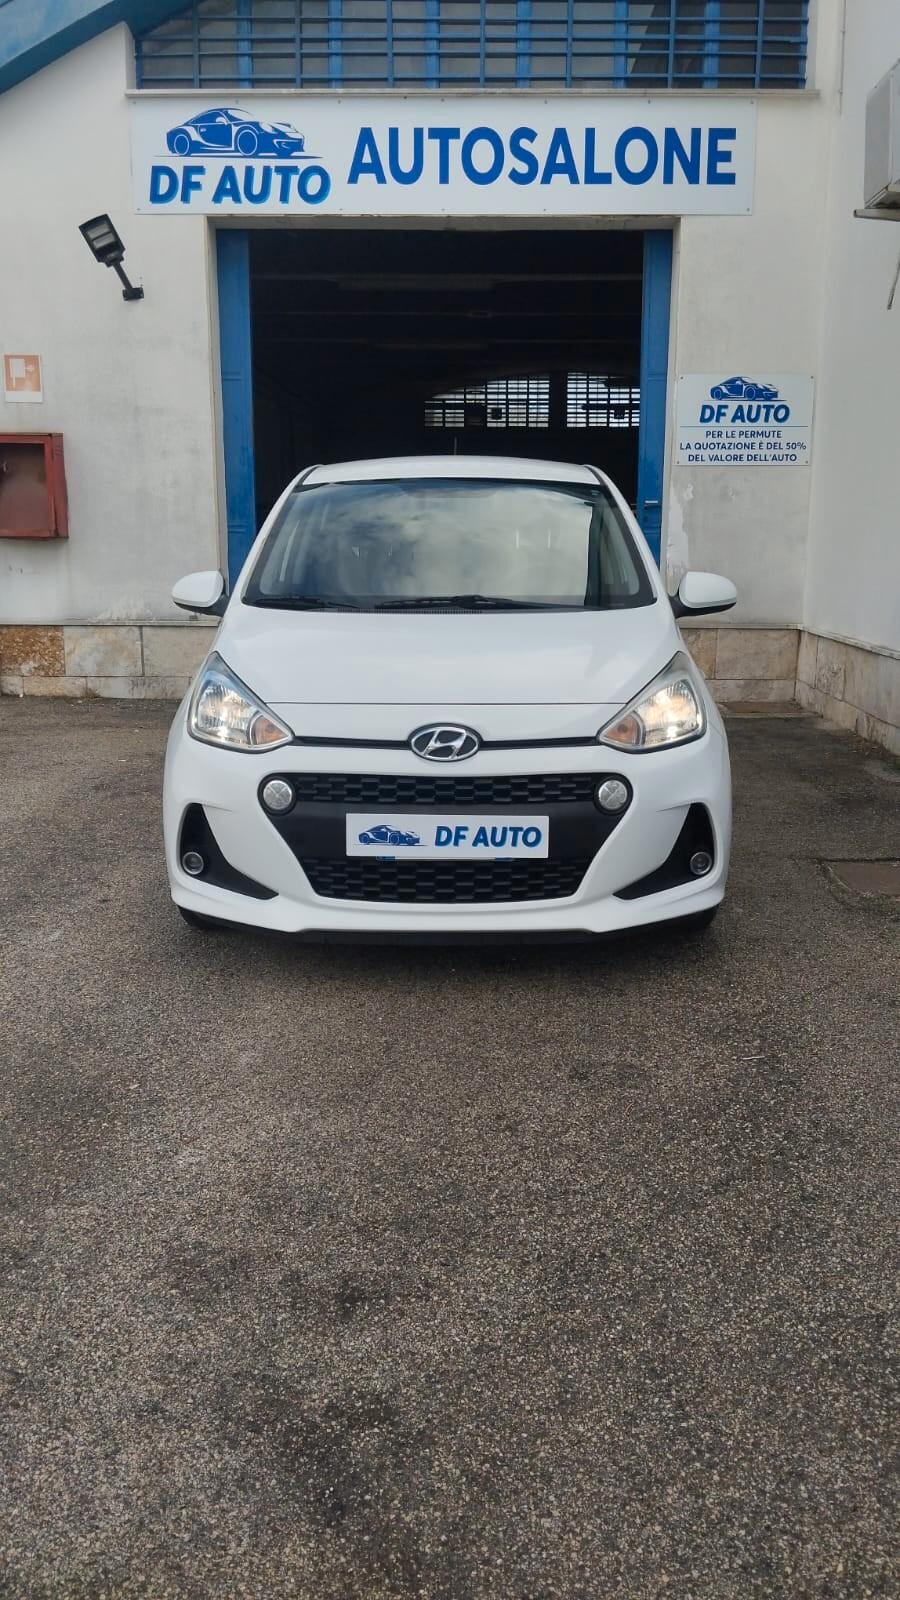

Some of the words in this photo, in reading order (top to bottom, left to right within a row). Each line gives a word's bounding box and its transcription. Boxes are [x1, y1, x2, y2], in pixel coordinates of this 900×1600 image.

[347, 126, 737, 186] AUTOSALONE
[149, 165, 206, 204] DF
[212, 165, 332, 206] AUTO
[700, 404, 728, 423] DF
[731, 404, 790, 423] AUTO
[694, 442, 756, 450] QUOTAZIONE
[758, 440, 764, 450] È
[708, 454, 744, 462] VALORE
[746, 454, 797, 462] DELL'AUTO
[434, 826, 468, 846] DF
[472, 826, 542, 847] AUTO
